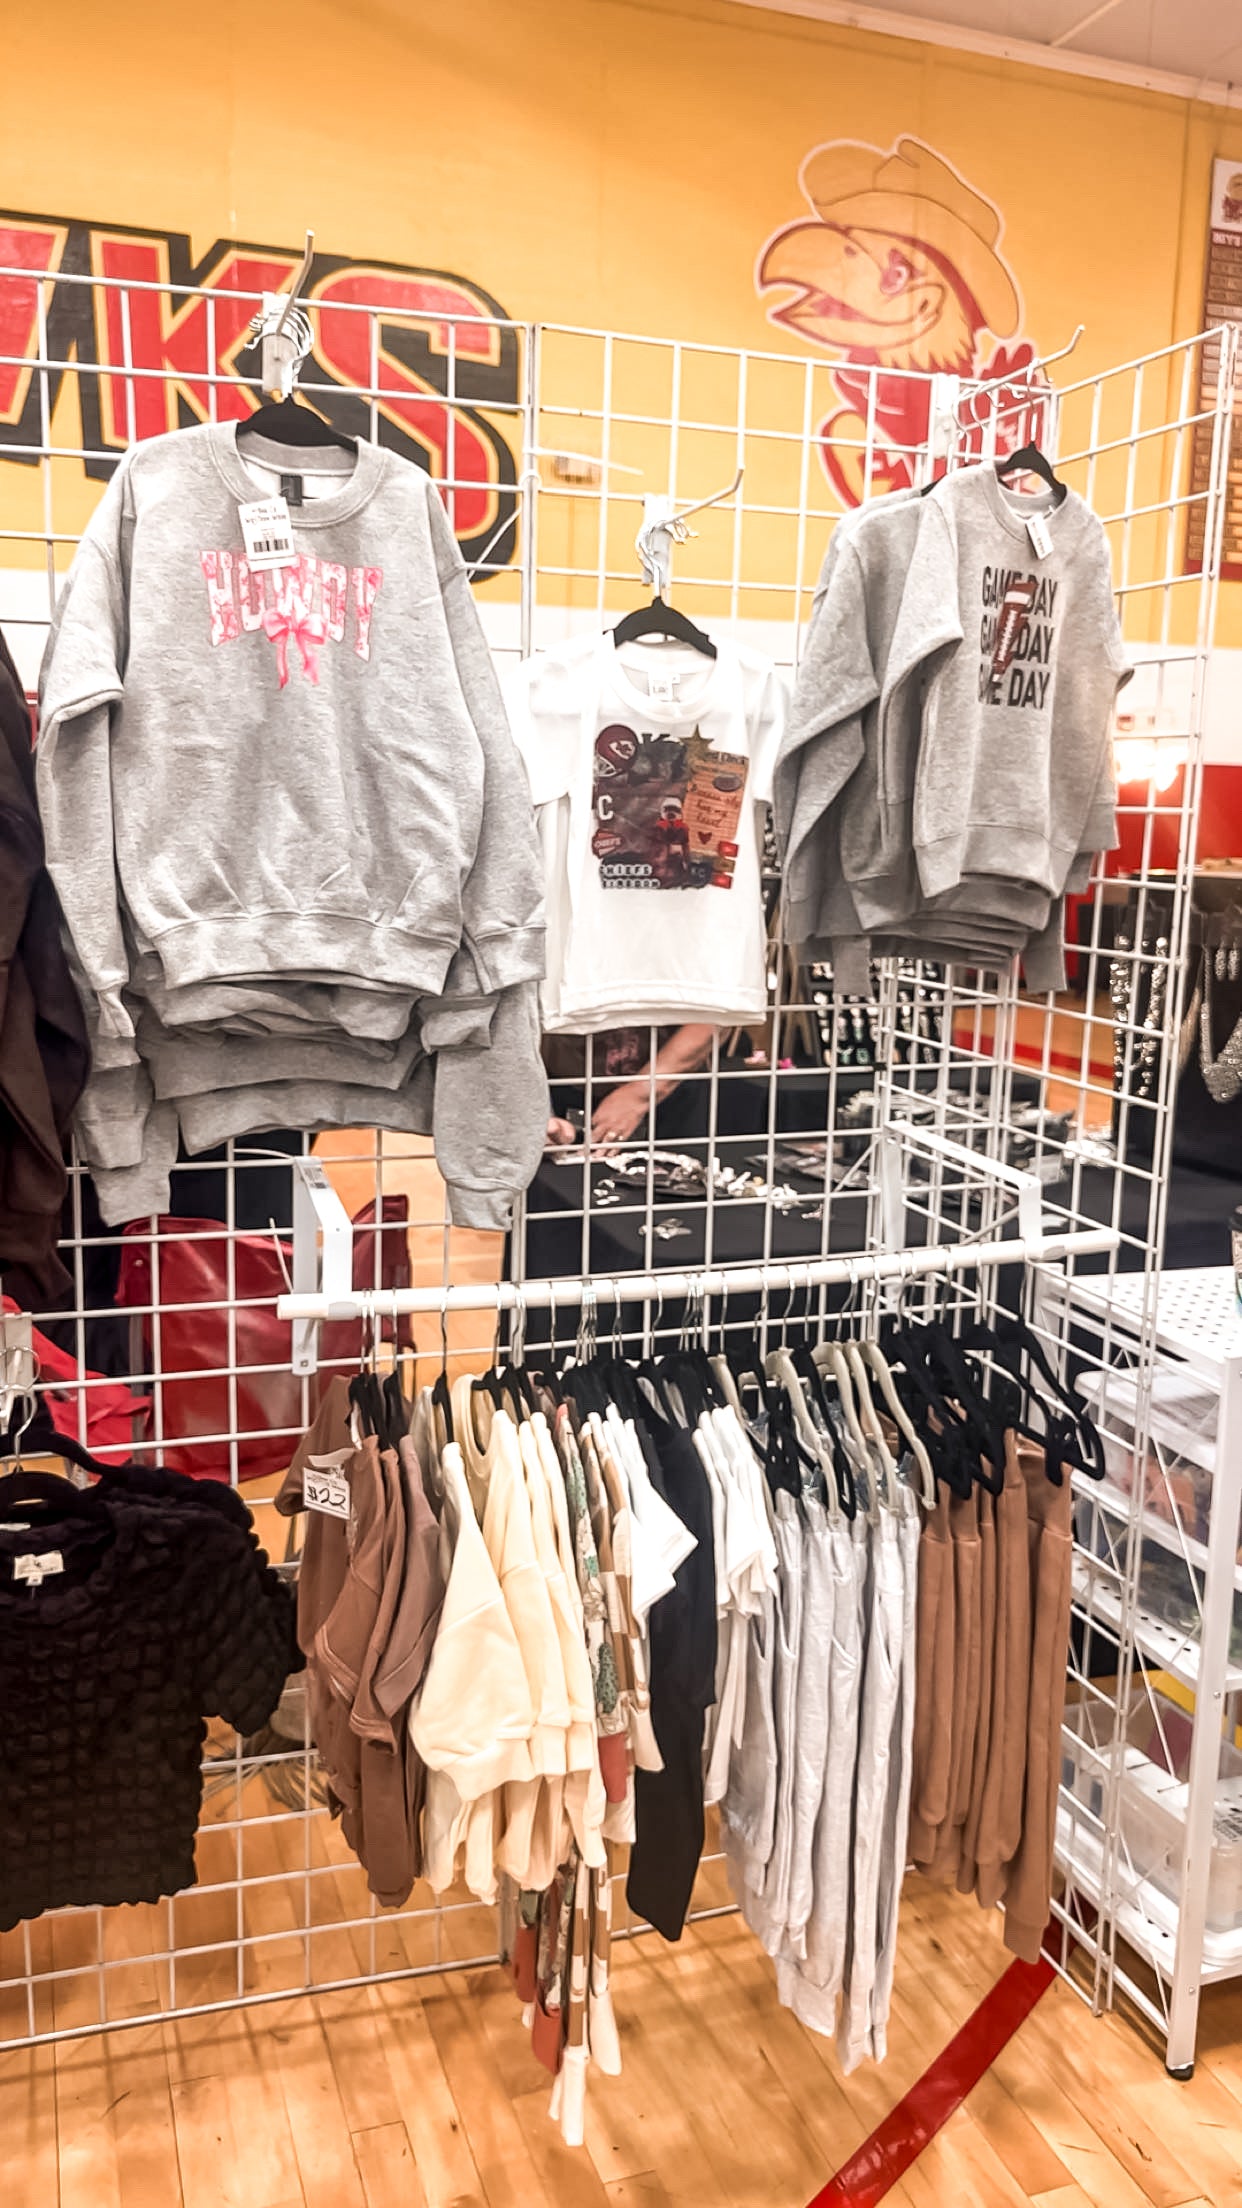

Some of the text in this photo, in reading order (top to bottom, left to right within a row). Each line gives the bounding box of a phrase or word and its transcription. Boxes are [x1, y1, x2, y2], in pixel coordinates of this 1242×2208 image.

[200, 548, 384, 662] HOWDY
[1013, 622, 1055, 665] DAY
[1008, 668, 1051, 710] DAY
[306, 1485, 346, 1511] $22
